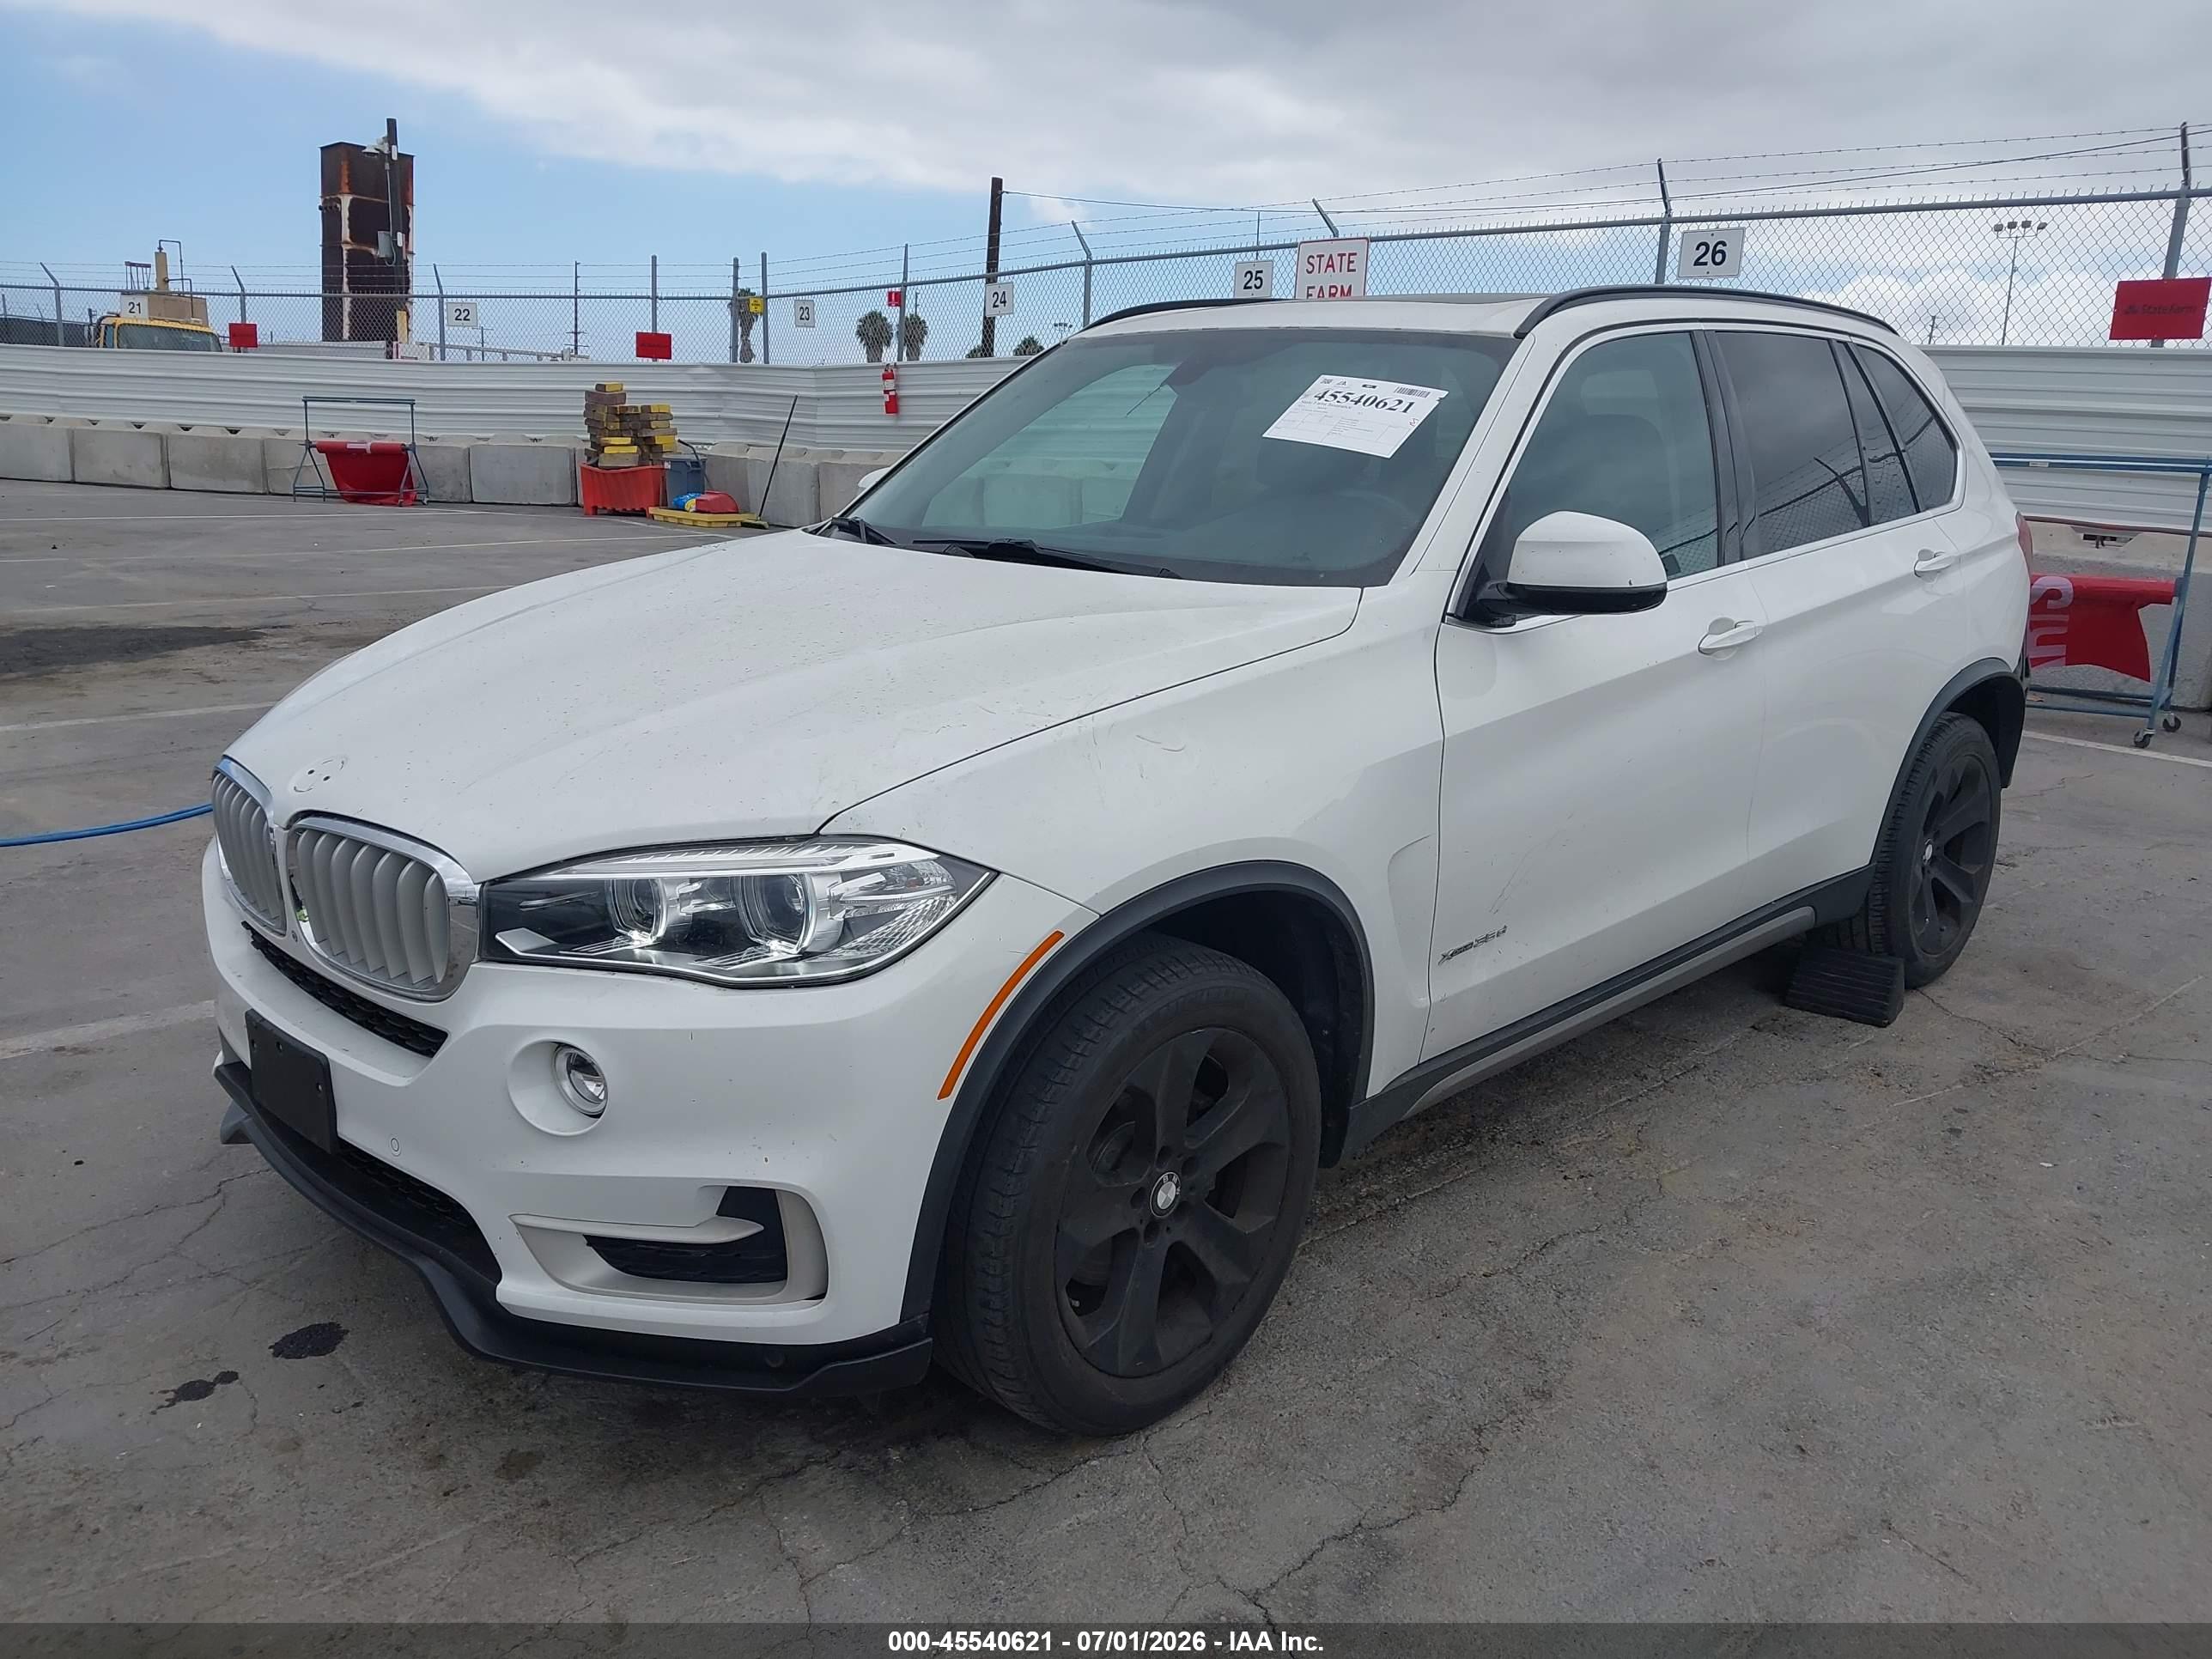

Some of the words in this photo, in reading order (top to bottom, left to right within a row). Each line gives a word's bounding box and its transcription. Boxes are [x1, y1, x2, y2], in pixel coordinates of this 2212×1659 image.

[1693, 240, 1727, 266] 26
[1306, 252, 1358, 275] STATE
[1243, 270, 1263, 290] 25
[992, 291, 1007, 308] 24
[1306, 284, 1352, 300] FARM
[128, 301, 143, 314] 21
[454, 308, 471, 321] 22
[799, 306, 811, 321] 23
[1314, 389, 1415, 413] 45540621
